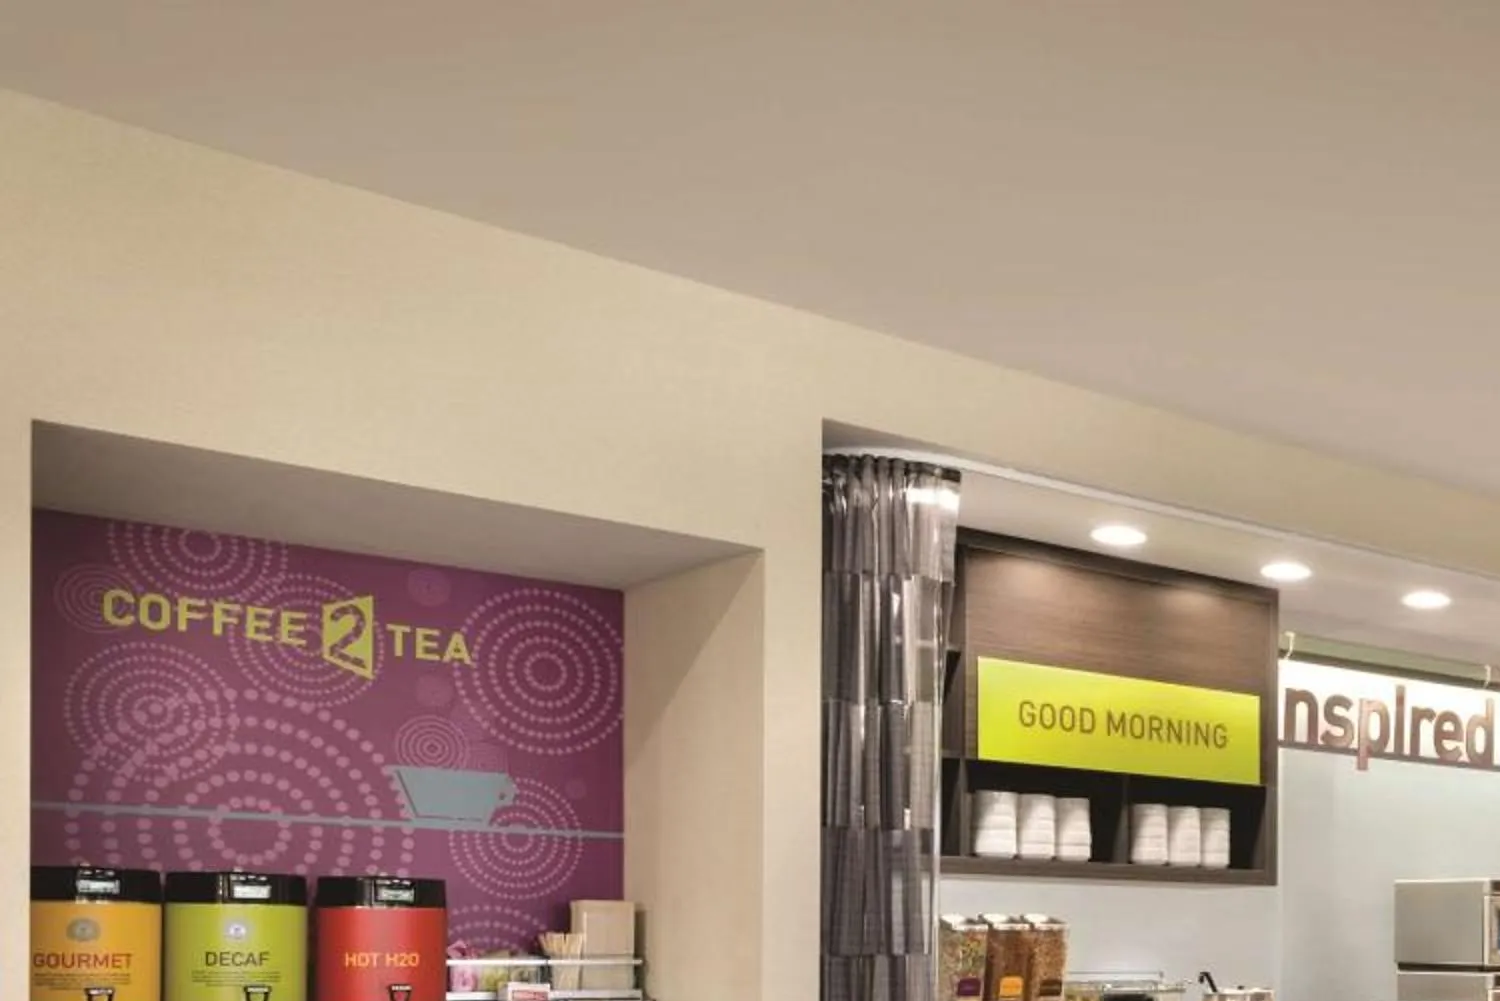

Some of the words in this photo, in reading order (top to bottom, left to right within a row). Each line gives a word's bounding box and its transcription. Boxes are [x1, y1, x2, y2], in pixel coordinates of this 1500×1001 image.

[103, 588, 308, 646] COFFEE
[387, 623, 473, 665] TEA
[1019, 700, 1096, 734] GOOD
[1106, 710, 1229, 749] MORNING
[1283, 685, 1494, 770] nspired
[33, 952, 133, 970] GOURMET
[205, 951, 270, 967] DECAF
[345, 952, 381, 968] HOT
